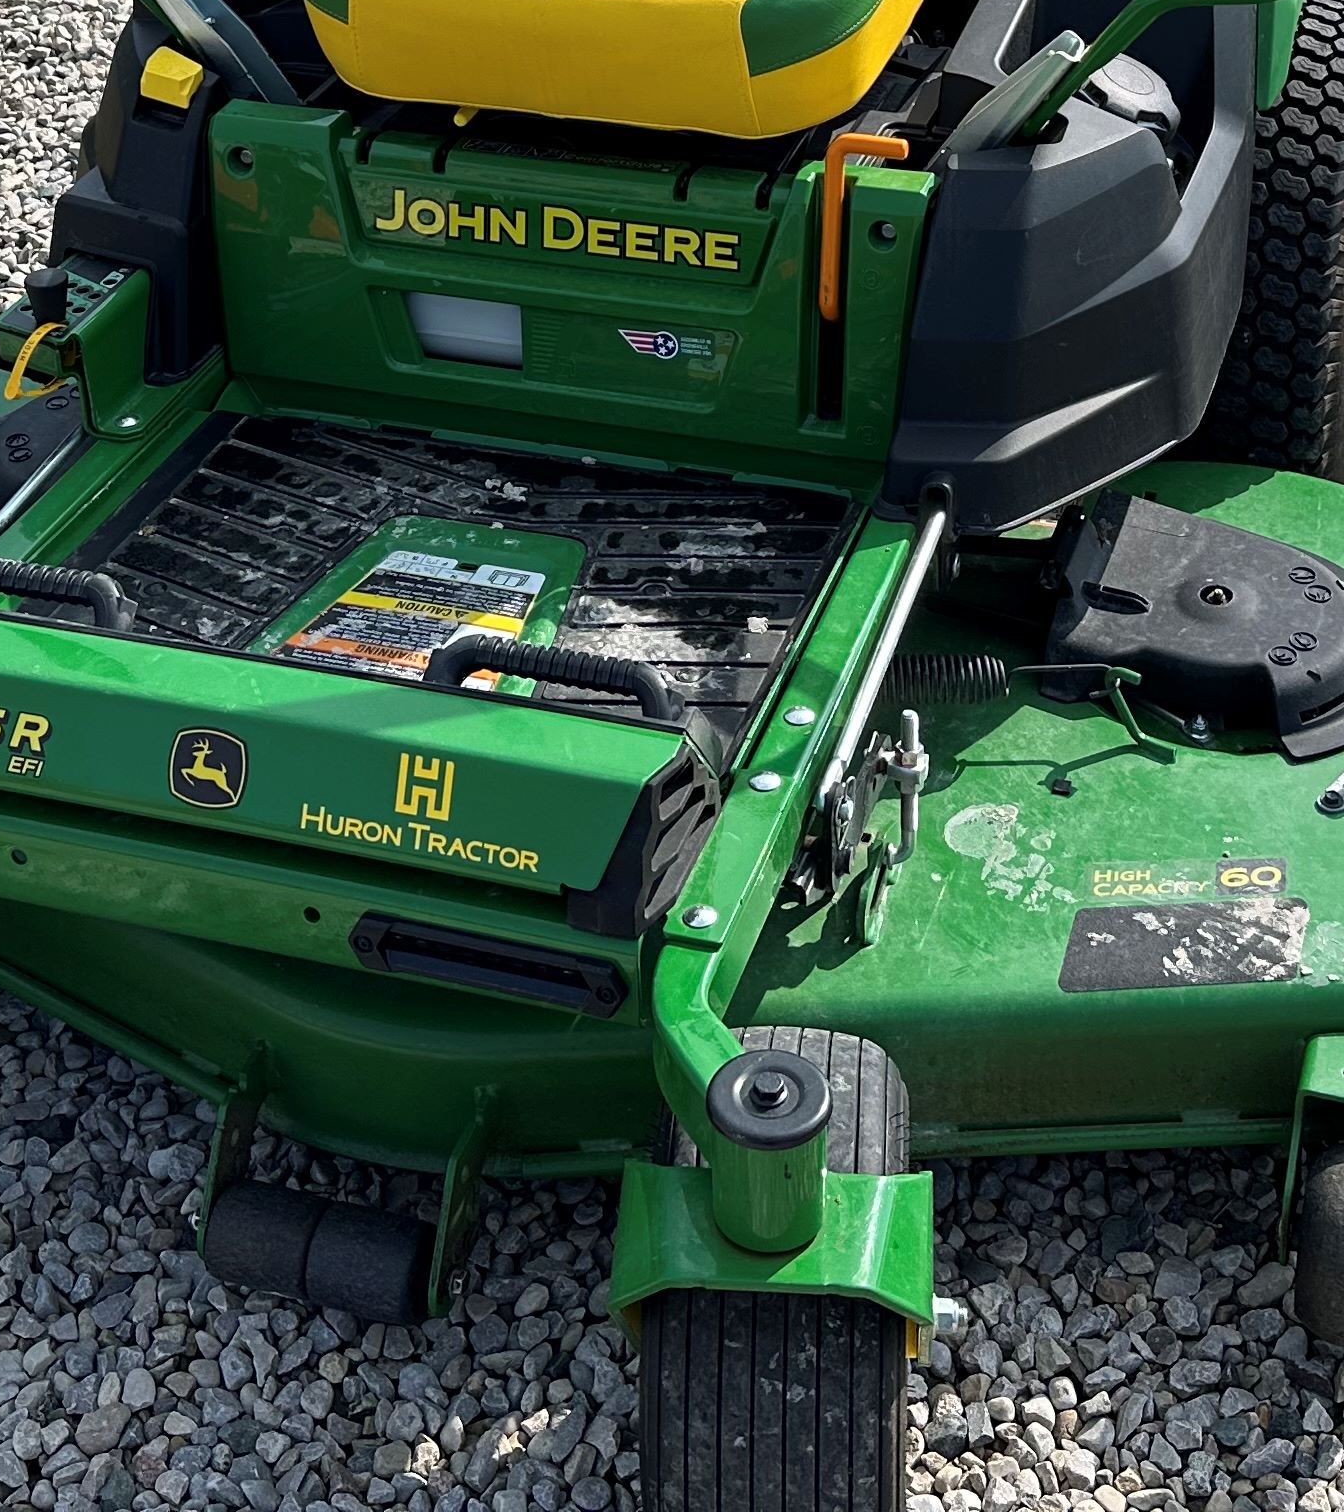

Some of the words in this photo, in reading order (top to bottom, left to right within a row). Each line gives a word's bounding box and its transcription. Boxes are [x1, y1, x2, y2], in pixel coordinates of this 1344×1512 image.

[375, 187, 528, 247] JOHN
[541, 204, 741, 273] DEERE
[394, 599, 453, 618] CAUTION
[353, 643, 419, 664] WARNING
[7, 755, 46, 778] EFI
[299, 802, 404, 848] HURON
[407, 821, 540, 874] TRACTOR
[1093, 869, 1151, 883] HIGH
[1219, 865, 1283, 888] 60
